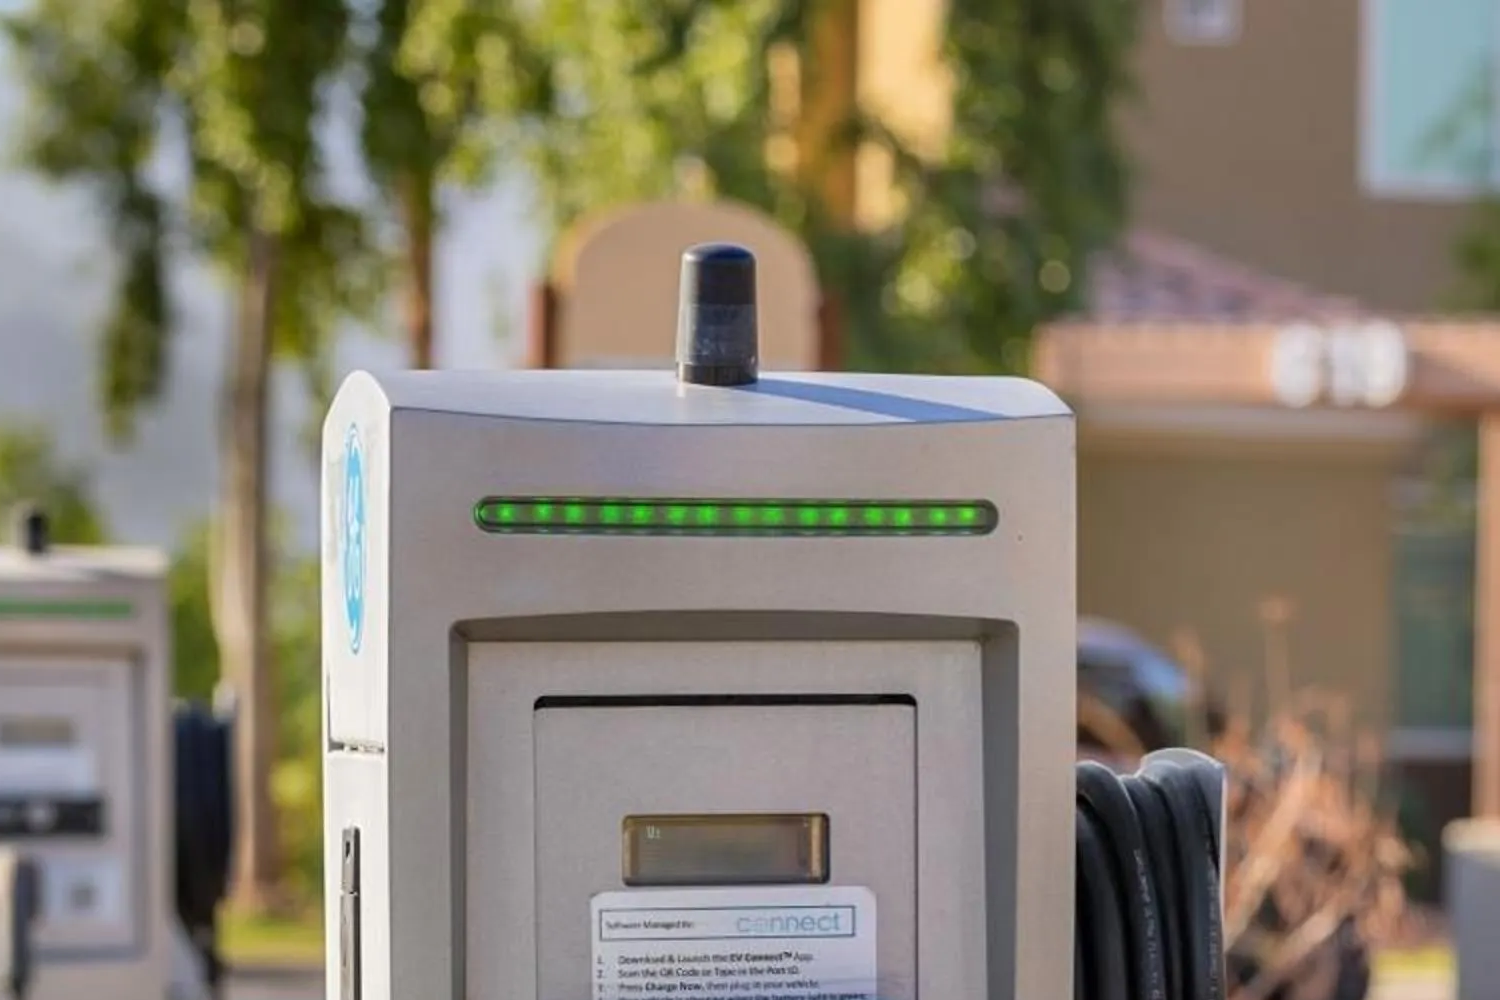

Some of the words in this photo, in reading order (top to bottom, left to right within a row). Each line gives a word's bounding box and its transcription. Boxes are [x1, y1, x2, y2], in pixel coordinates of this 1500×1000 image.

[737, 913, 841, 932] connect
[618, 953, 665, 964] Download
[618, 969, 642, 978] Scan
[676, 967, 700, 977] Code
[645, 982, 677, 994] Charge
